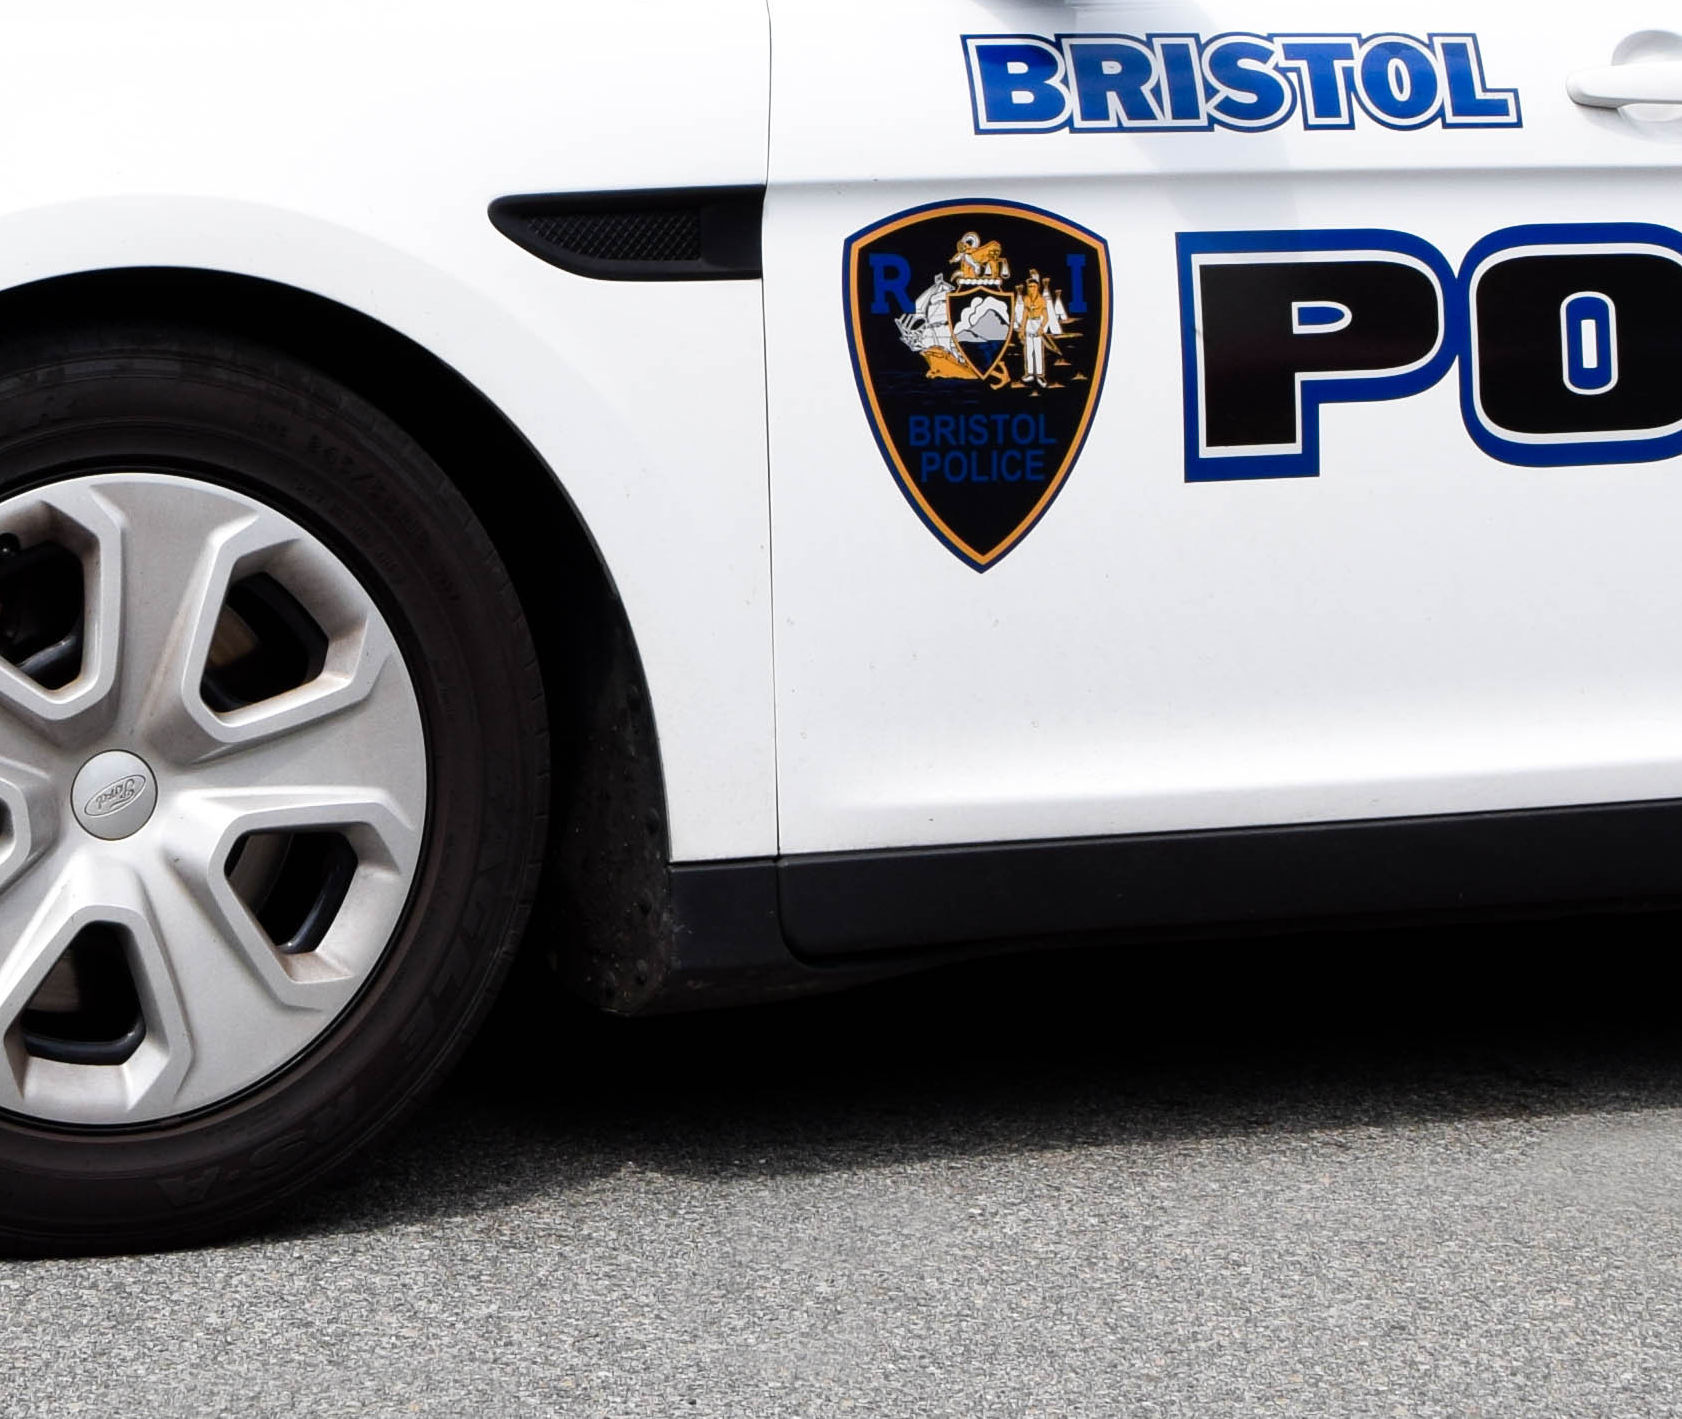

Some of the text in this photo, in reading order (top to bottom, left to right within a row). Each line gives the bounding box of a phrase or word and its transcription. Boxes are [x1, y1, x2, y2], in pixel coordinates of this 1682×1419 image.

[960, 32, 1523, 134] BRISTOL
[869, 253, 1087, 314] R I
[908, 414, 1056, 447] BRISTOL
[922, 449, 1047, 482] POLICE
[95, 778, 135, 809] Ford
